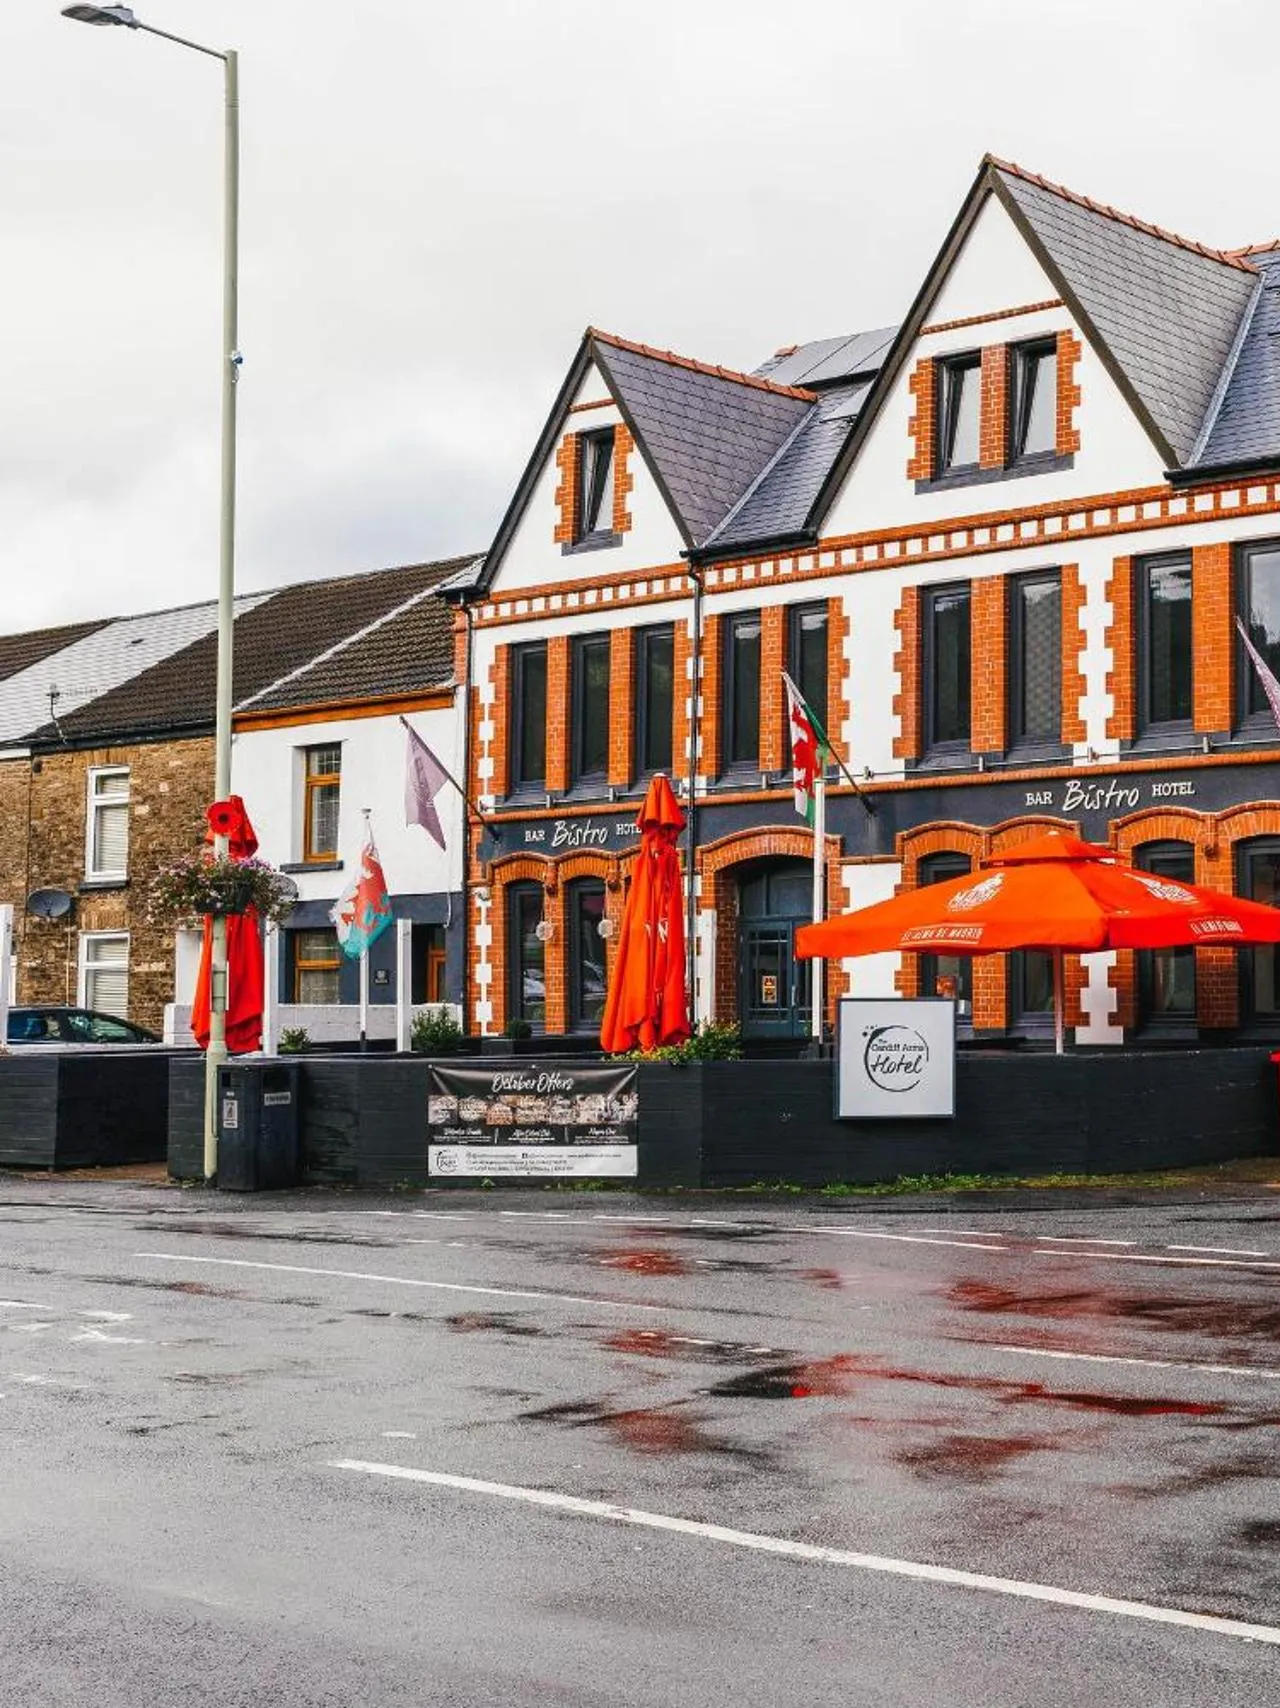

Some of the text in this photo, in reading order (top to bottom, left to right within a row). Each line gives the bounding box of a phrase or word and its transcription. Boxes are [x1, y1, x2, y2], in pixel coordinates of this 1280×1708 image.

[1025, 779, 1196, 812] BAR Bistro HOTEL
[525, 818, 643, 848] BAR Bistro HOTE
[870, 1054, 923, 1074] Hotel
